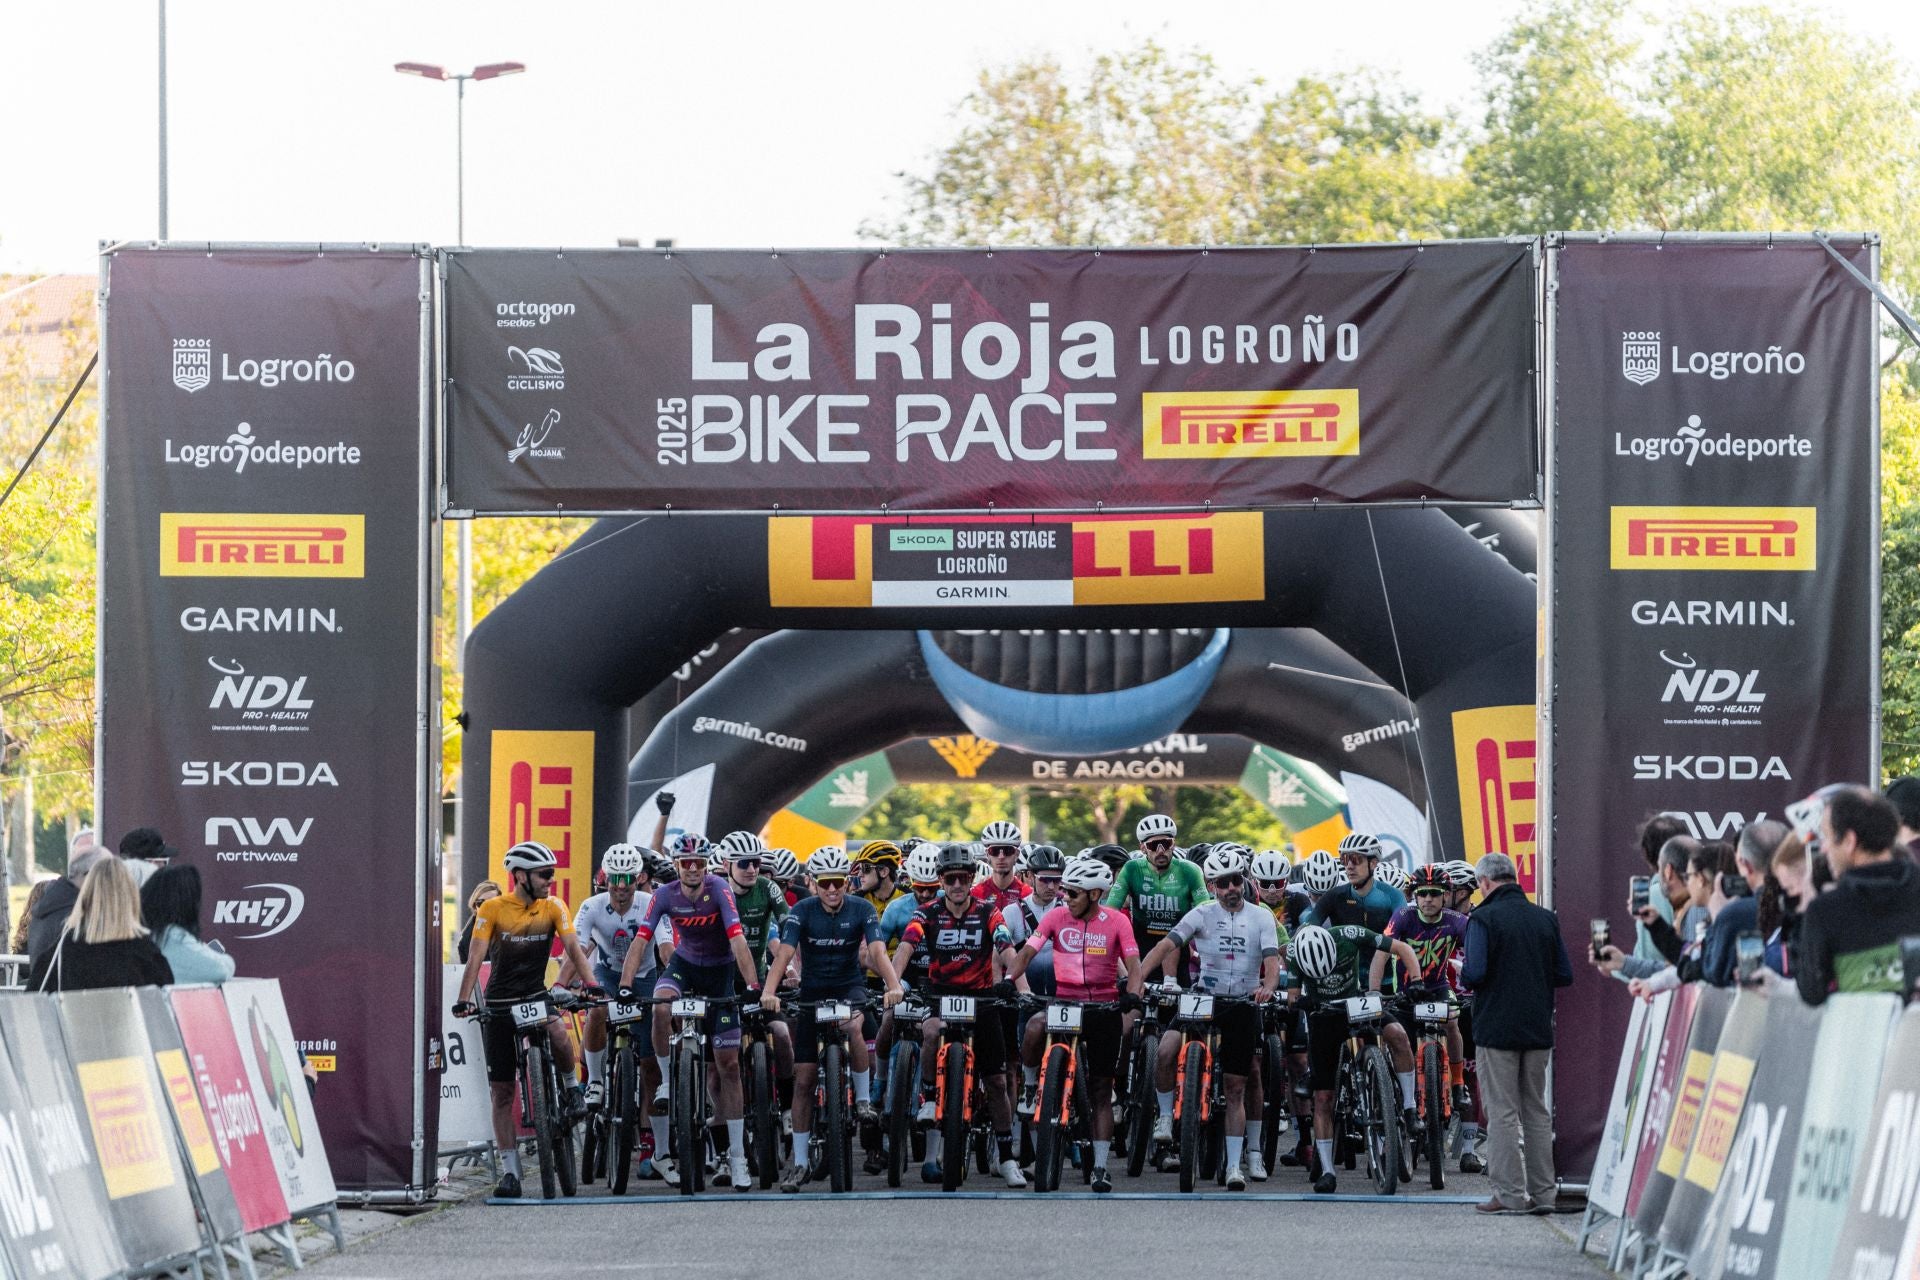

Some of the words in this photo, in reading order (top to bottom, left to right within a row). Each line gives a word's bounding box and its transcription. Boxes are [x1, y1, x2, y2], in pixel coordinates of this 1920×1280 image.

[496, 300, 576, 324] octagon
[496, 317, 536, 327] esedos
[691, 303, 811, 381] La
[854, 302, 1116, 393] Rioja
[1140, 314, 1360, 365] LOGROÑO
[221, 353, 355, 387] Logroño
[1671, 345, 1806, 380] Logroño
[507, 380, 565, 390] CICLISMO
[656, 396, 688, 466] 2025
[691, 393, 871, 464] BIKE
[895, 391, 1118, 463] RACE
[1160, 402, 1341, 446] PIRELLI
[530, 449, 562, 457] RIOJANA
[177, 526, 347, 565] PIRELLI
[956, 530, 1005, 549] SUPER
[1009, 530, 1057, 549] STAGE
[1627, 518, 1799, 557] PIRELLI
[936, 554, 1008, 574] LOGROÑO
[936, 586, 1009, 599] GARMIN
[179, 606, 337, 632] GARMIN
[1630, 600, 1789, 626] GARMIN
[208, 675, 315, 709] NDL
[1660, 669, 1767, 703] NDL
[241, 711, 263, 720] PRO
[270, 711, 309, 720] HEALTH
[1694, 704, 1715, 713] PRO
[1722, 704, 1761, 713] HEALTH
[691, 716, 808, 753] garmin.com
[1032, 760, 1068, 779] DE
[1073, 756, 1185, 779] ARAGÓN
[216, 851, 299, 862] northwave
[1138, 893, 1181, 912] PEDAL
[1145, 911, 1177, 920] STORE
[935, 928, 983, 946] BH
[1069, 932, 1080, 940] La
[520, 1003, 539, 1019] 95
[682, 1001, 696, 1012] 13
[905, 1001, 918, 1013] 12
[949, 998, 968, 1013] 101
[1193, 996, 1200, 1013] 7
[1359, 998, 1369, 1011] 2
[1427, 1004, 1436, 1014] 9
[1059, 1007, 1069, 1023] 6
